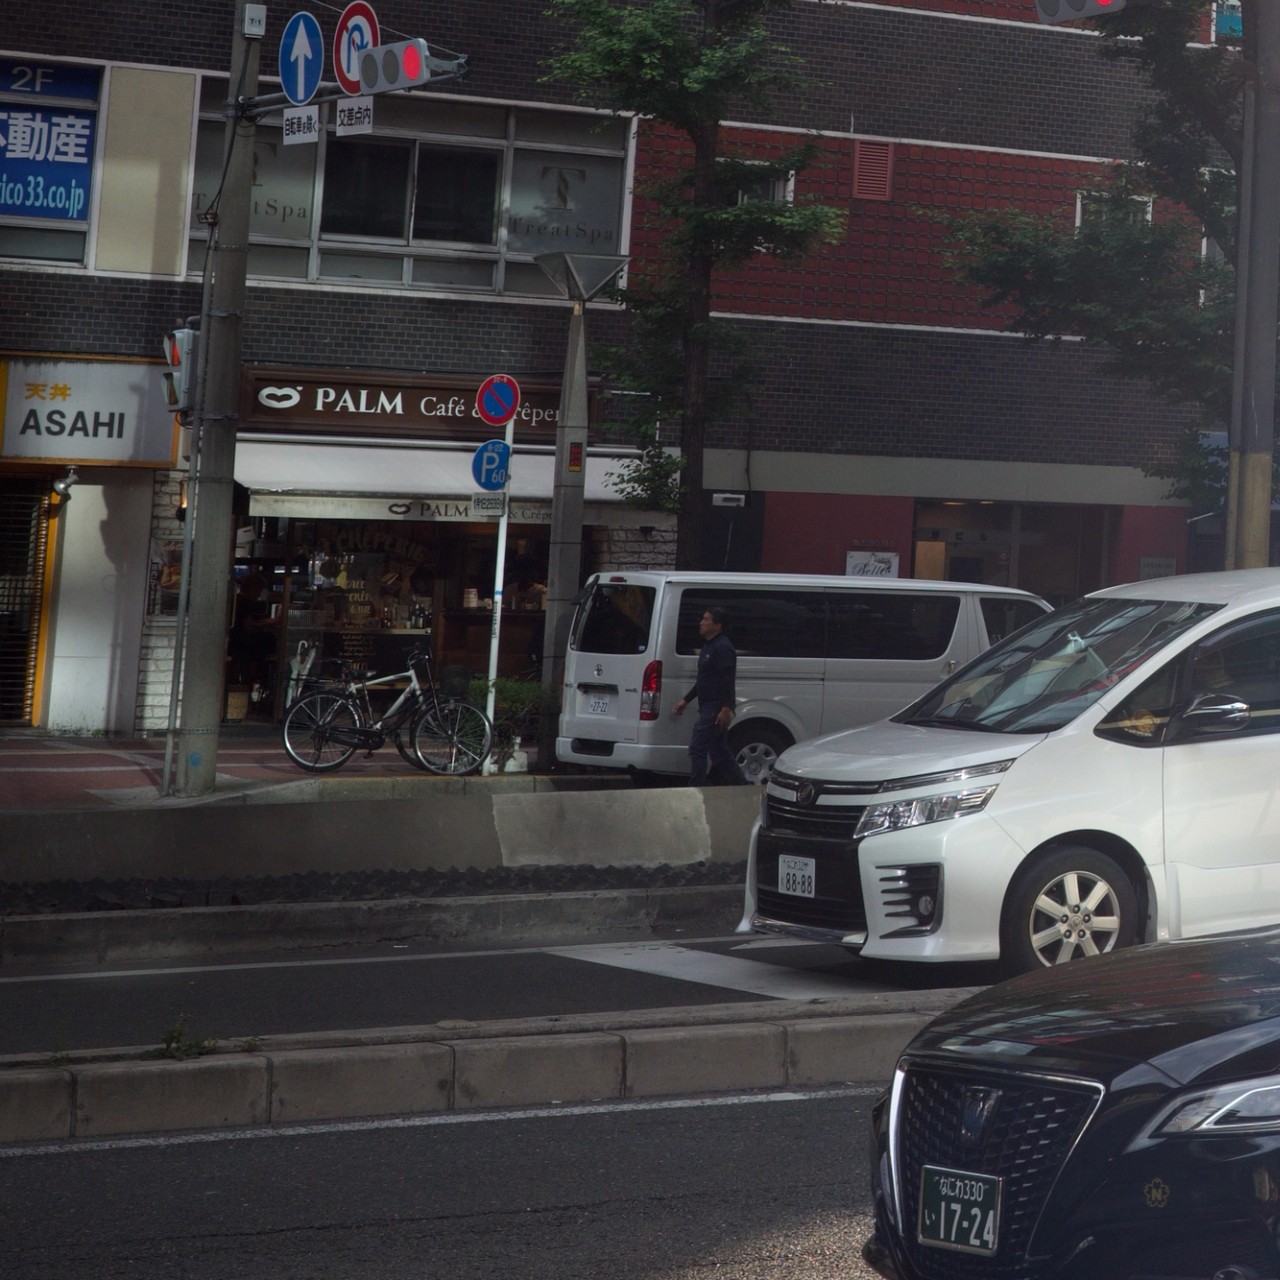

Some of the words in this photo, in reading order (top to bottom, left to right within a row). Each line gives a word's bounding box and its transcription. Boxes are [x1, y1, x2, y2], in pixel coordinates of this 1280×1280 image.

[10, 66, 54, 92] 2F
[285, 114, 317, 136] 自転車を除く
[338, 105, 371, 127] 交差点内
[315, 387, 404, 415] PALM
[420, 396, 464, 417] Café
[20, 408, 125, 438] ASAHI
[481, 452, 499, 483] P
[492, 469, 506, 483] 60
[420, 503, 469, 518] PALM
[785, 871, 813, 895] 88-88
[940, 1201, 994, 1249] 17-24
